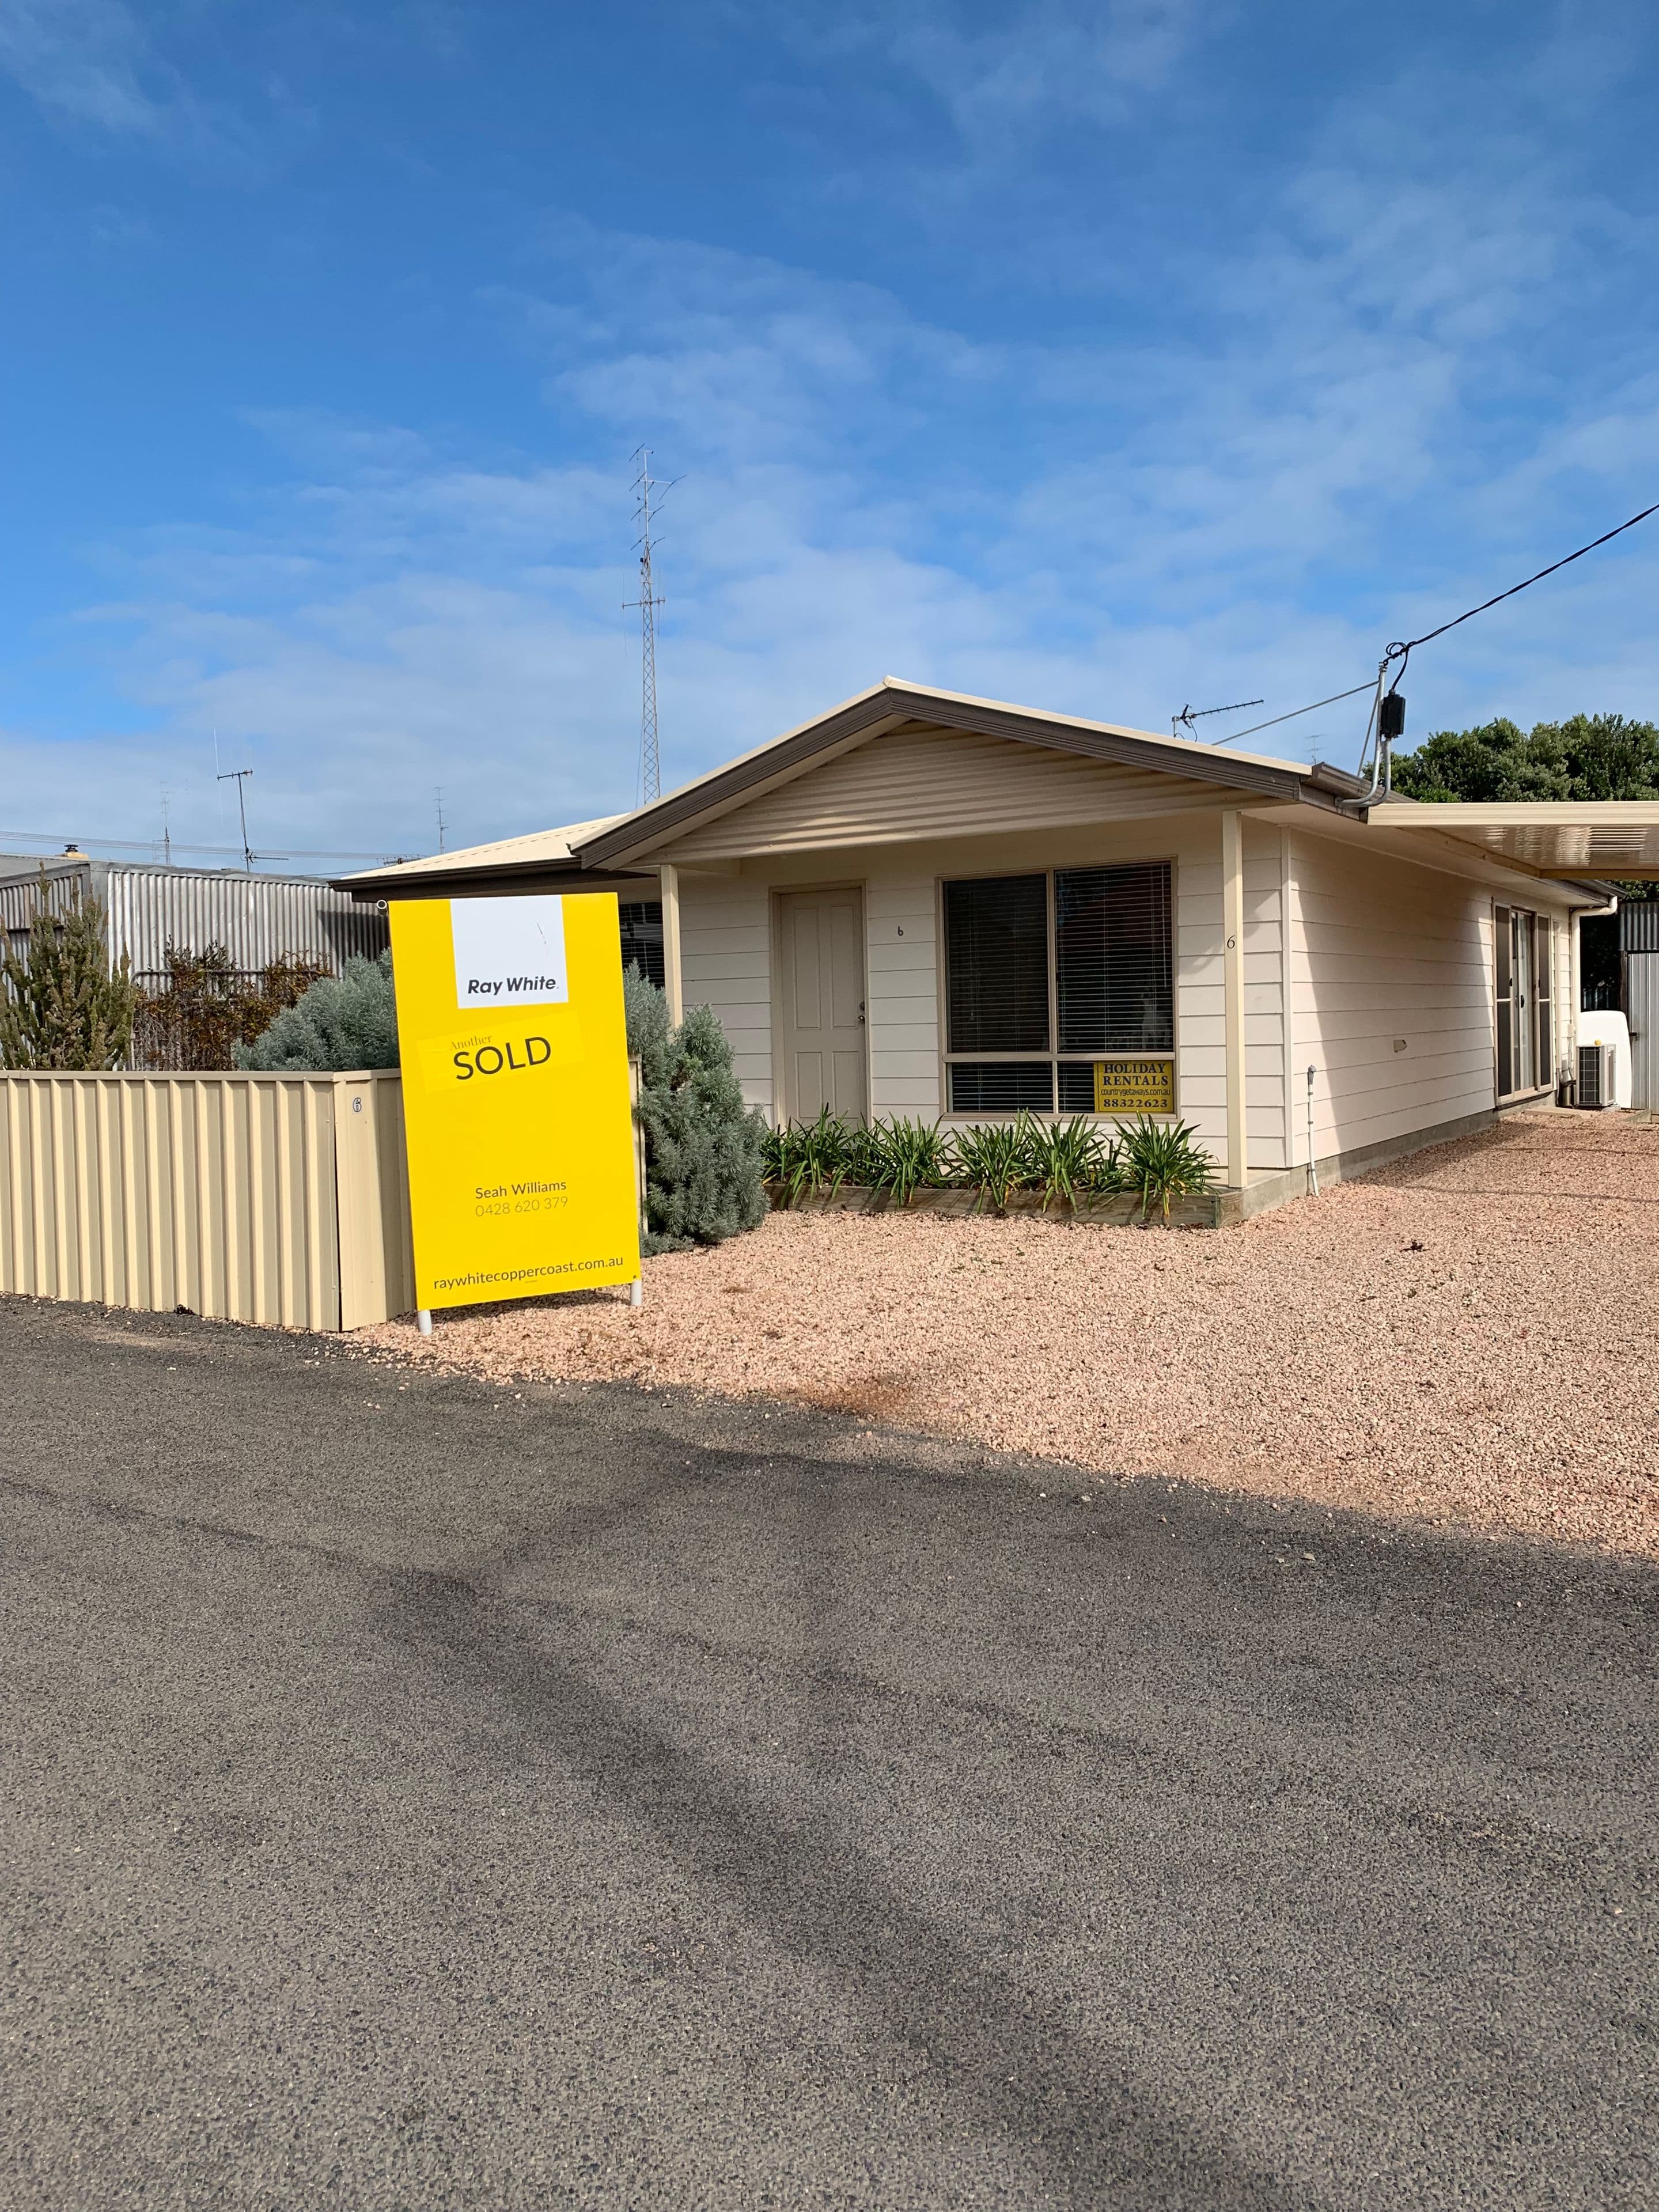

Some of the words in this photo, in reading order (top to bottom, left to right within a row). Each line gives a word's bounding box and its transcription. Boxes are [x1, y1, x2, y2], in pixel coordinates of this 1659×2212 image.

[1227, 935, 1235, 949] 6
[467, 979, 502, 996] Ray
[506, 976, 556, 992] White
[449, 1035, 493, 1051] Another
[453, 1036, 552, 1080] SOLD
[1104, 1063, 1166, 1074] HOLIDAY
[1103, 1075, 1168, 1086] RENTALS
[1101, 1088, 1171, 1097] countrygetaways.com.au
[353, 1097, 362, 1112] 6
[1103, 1099, 1168, 1107] 88322623
[475, 1185, 507, 1199] Seah
[511, 1180, 567, 1196] Williams
[475, 1202, 510, 1217] 0428
[514, 1198, 540, 1213] 620
[544, 1196, 569, 1210] 379
[434, 1256, 624, 1290] raywhitecoppercoast.com.au
